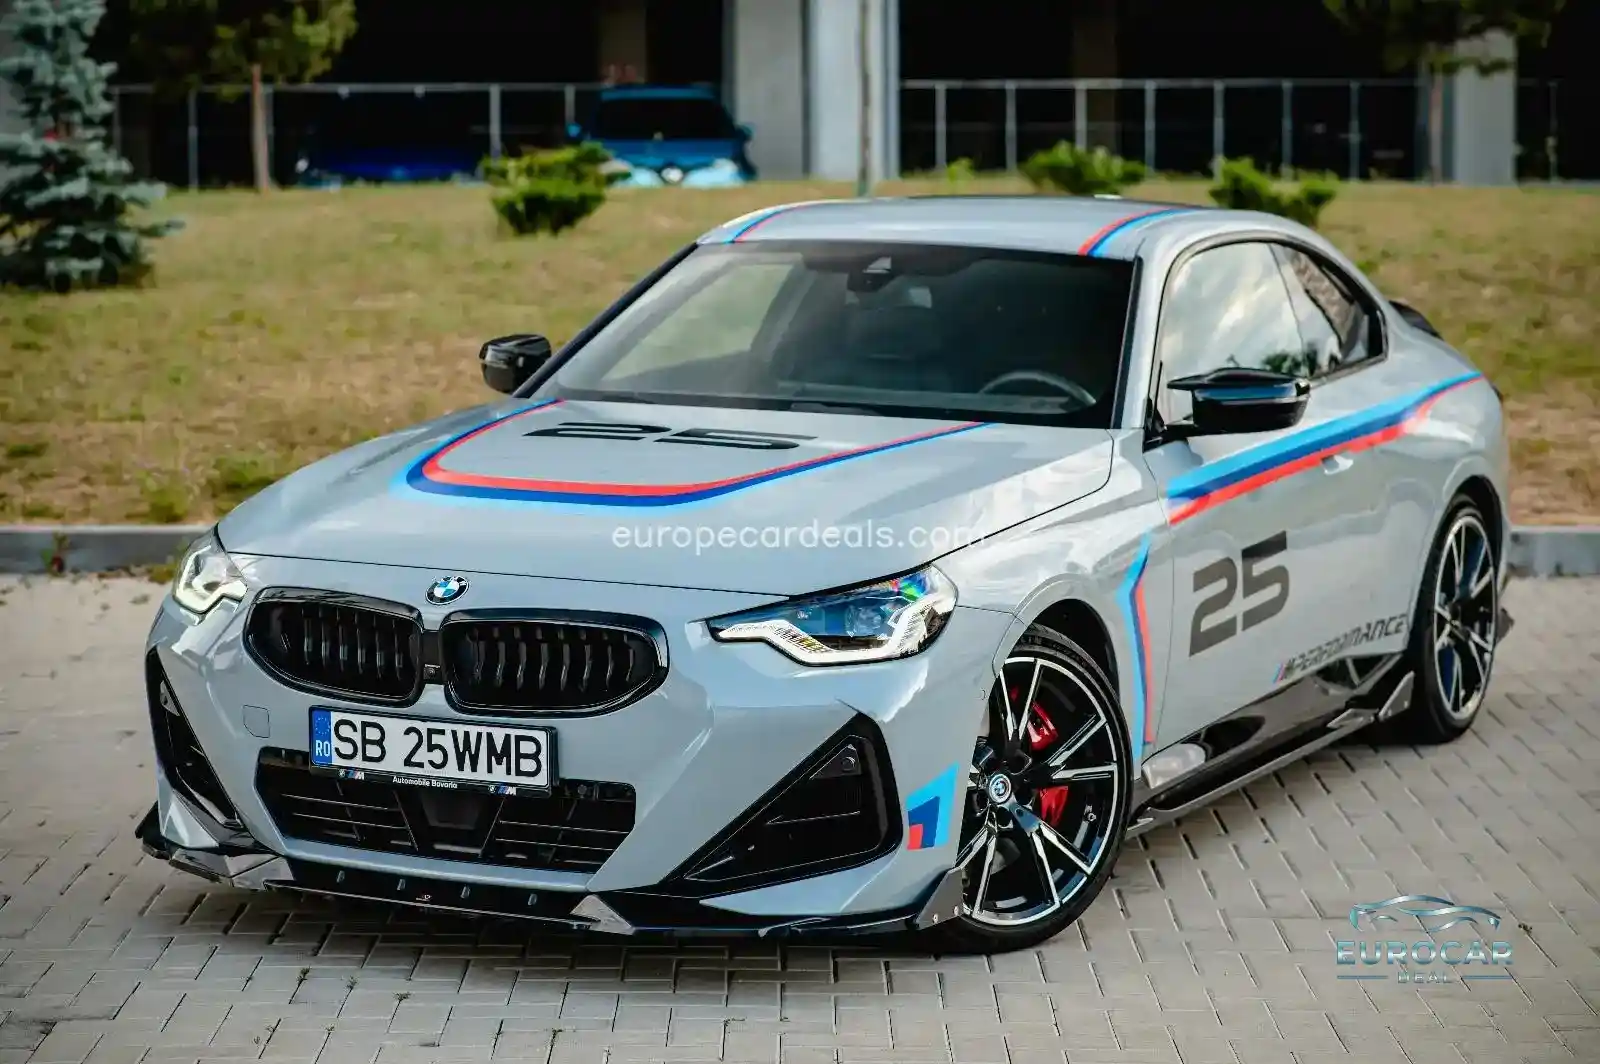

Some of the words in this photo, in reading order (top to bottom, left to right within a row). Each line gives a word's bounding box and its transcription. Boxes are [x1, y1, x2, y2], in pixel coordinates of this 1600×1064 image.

[522, 422, 818, 450] 25
[1189, 530, 1290, 657] 25
[315, 740, 331, 757] RO
[333, 718, 387, 763] SB
[403, 726, 543, 778] 25WMB
[392, 776, 431, 787] Automobile
[431, 778, 458, 789] Bavaria
